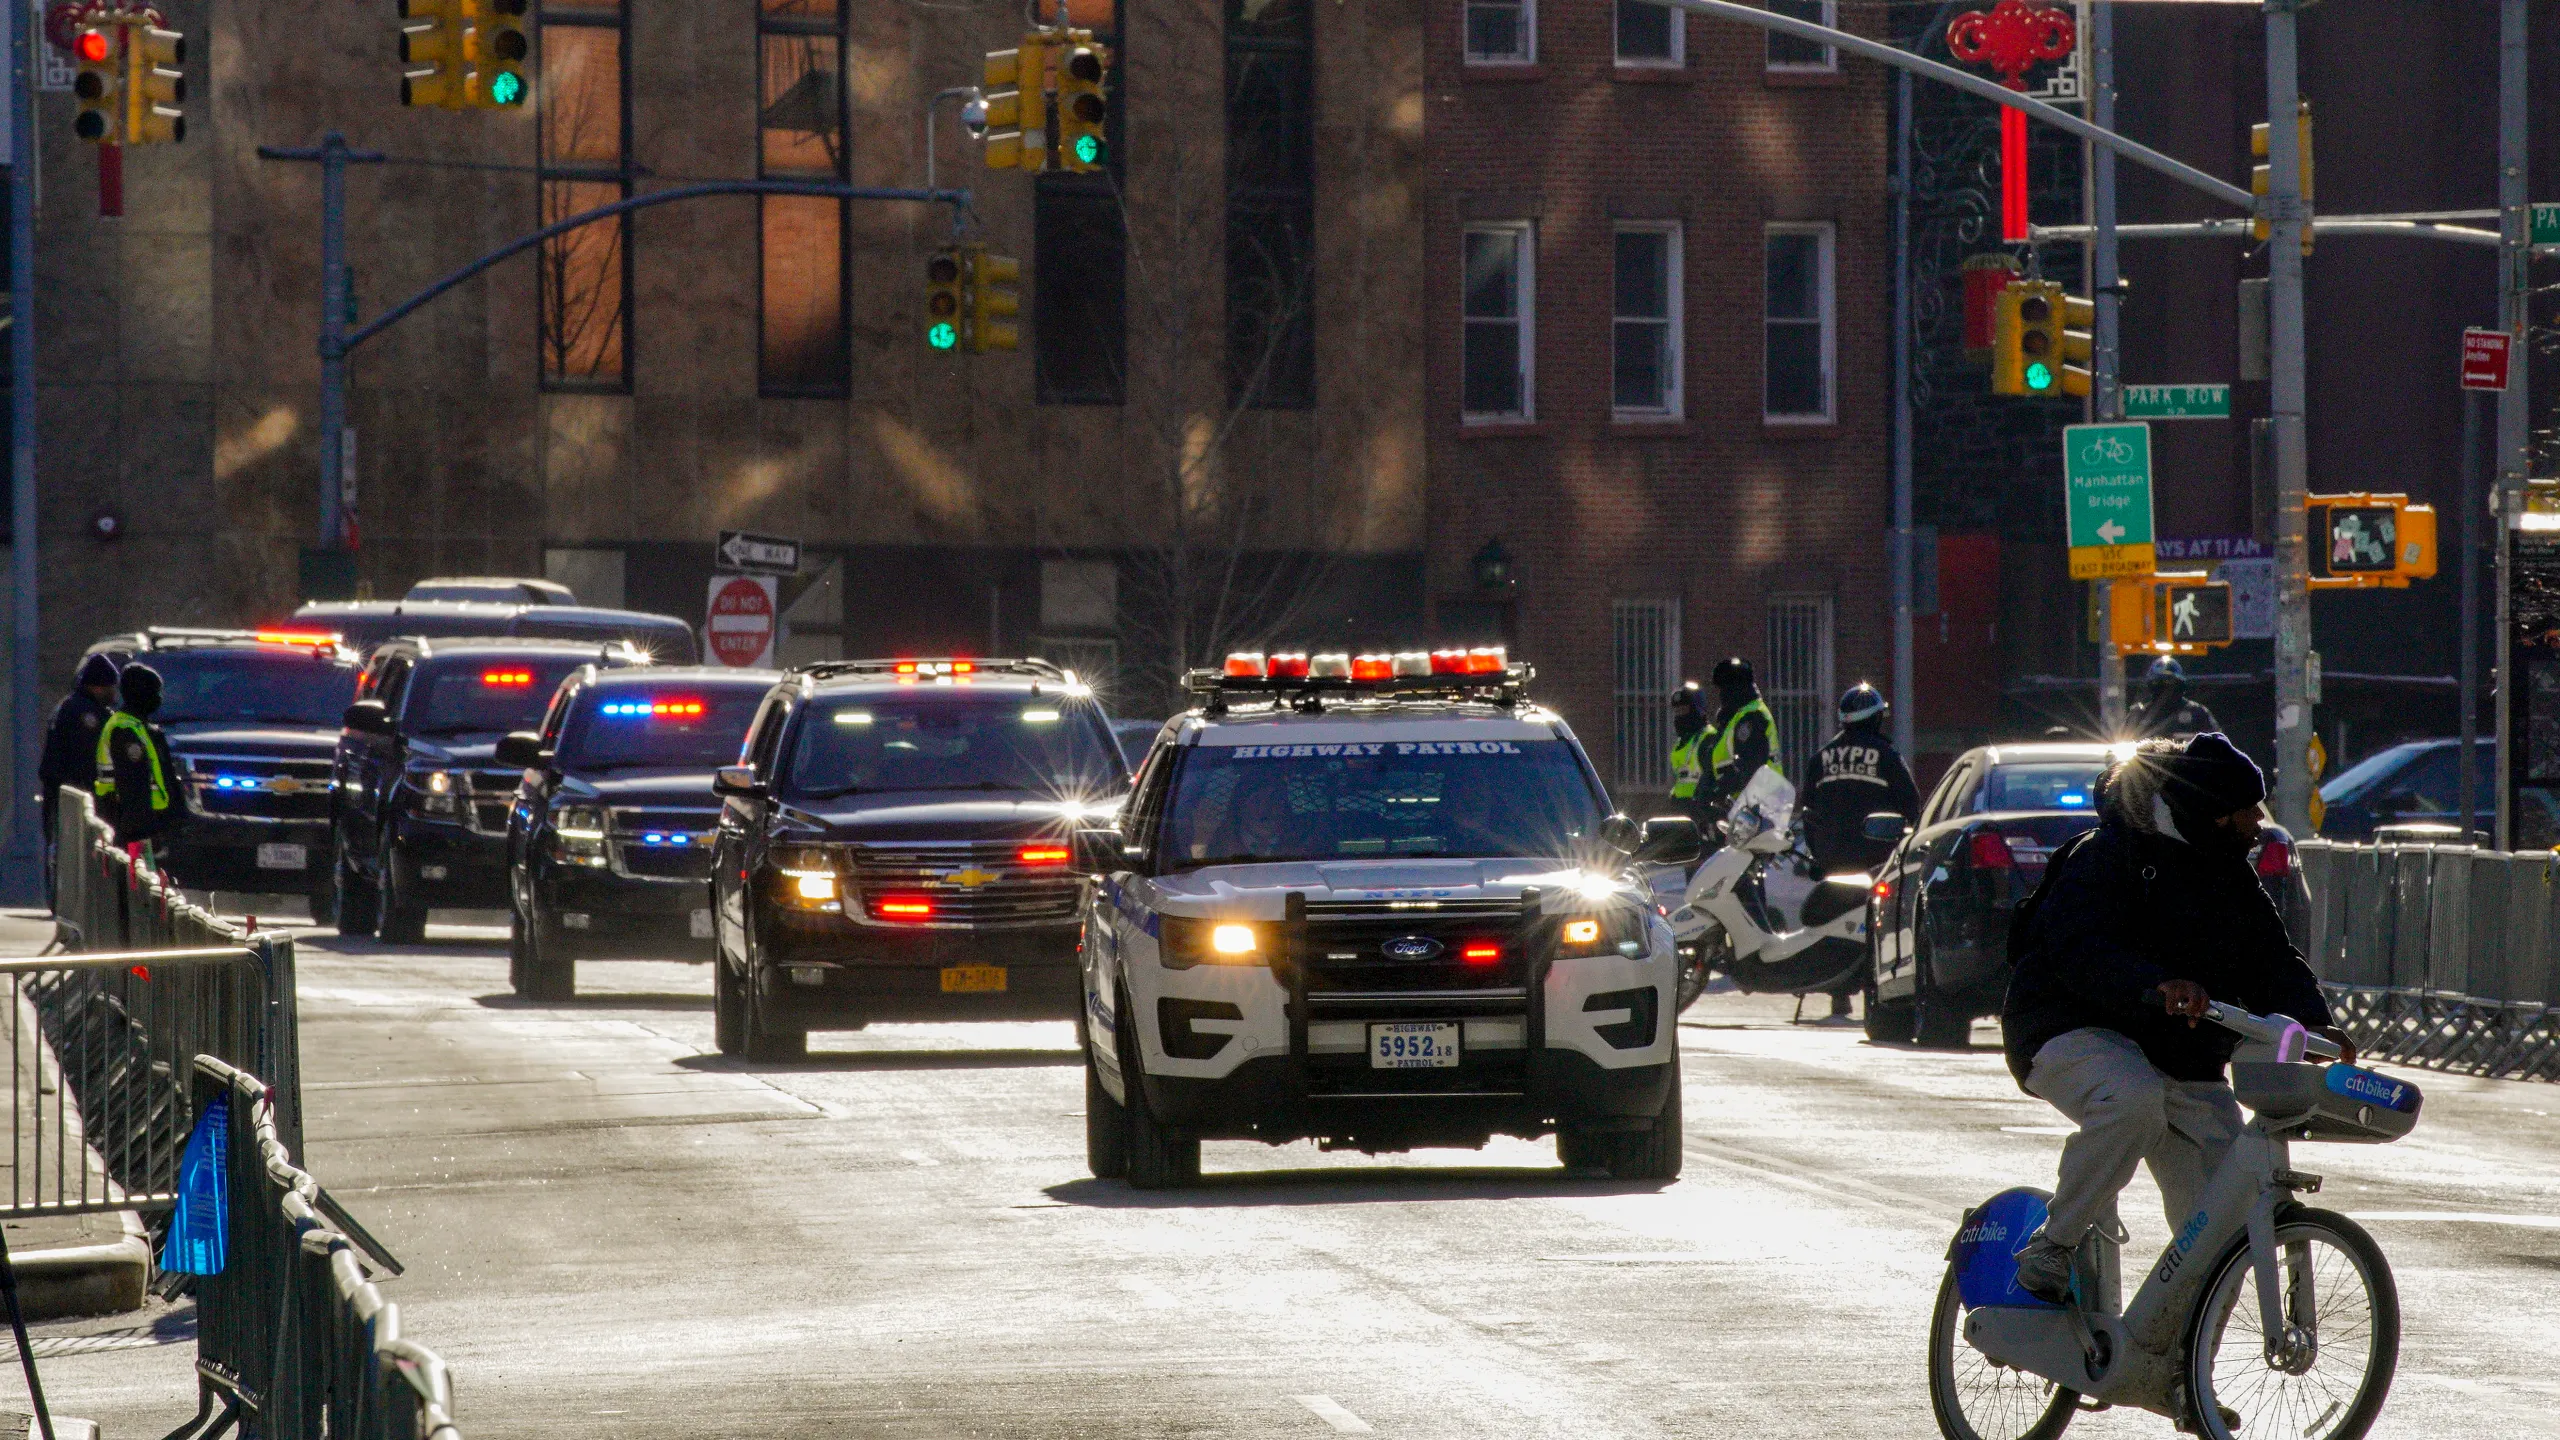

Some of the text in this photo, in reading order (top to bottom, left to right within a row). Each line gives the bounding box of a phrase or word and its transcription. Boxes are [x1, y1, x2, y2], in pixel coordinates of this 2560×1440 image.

[2129, 387, 2223, 405] PARK ROW
[2074, 475, 2144, 489] Manhattan
[2088, 495, 2131, 509] Bridge
[729, 541, 790, 561] ONE WAY
[2189, 539, 2212, 555] AT
[2074, 561, 2152, 573] EAST BROADWAY
[720, 596, 764, 611] DO NOT
[720, 636, 760, 651] ENTER
[1232, 741, 1521, 758] HIGHWAY PATROL
[1821, 746, 1880, 766] NYPD
[1364, 889, 1452, 898] NYPD
[1394, 942, 1429, 954] Ford
[1393, 1022, 1437, 1033] HIGHWAY
[1380, 1035, 1453, 1057] 5952 18
[1397, 1059, 1434, 1068] PATROL
